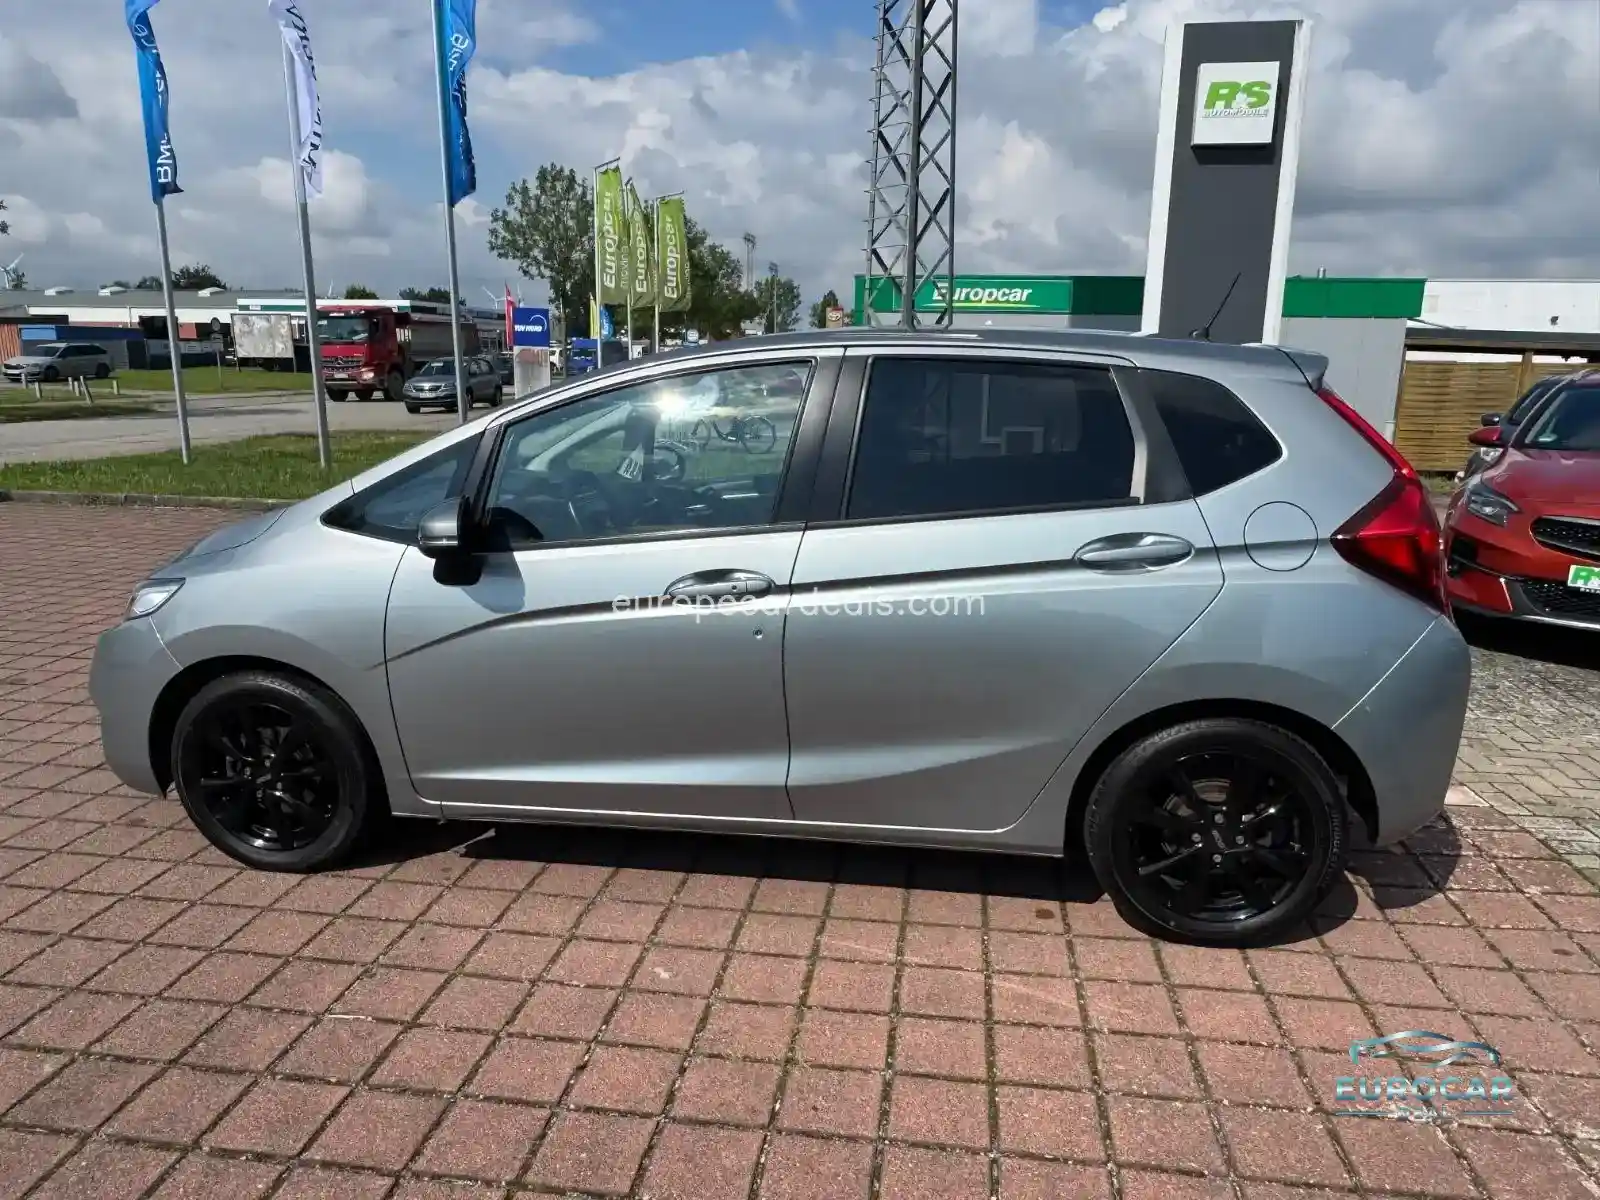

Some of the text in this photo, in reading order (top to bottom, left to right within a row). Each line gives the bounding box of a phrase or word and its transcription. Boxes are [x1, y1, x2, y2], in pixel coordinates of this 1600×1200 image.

[603, 190, 619, 289] Europcar
[664, 214, 681, 299] Europcar
[932, 282, 1033, 305] Europcar
